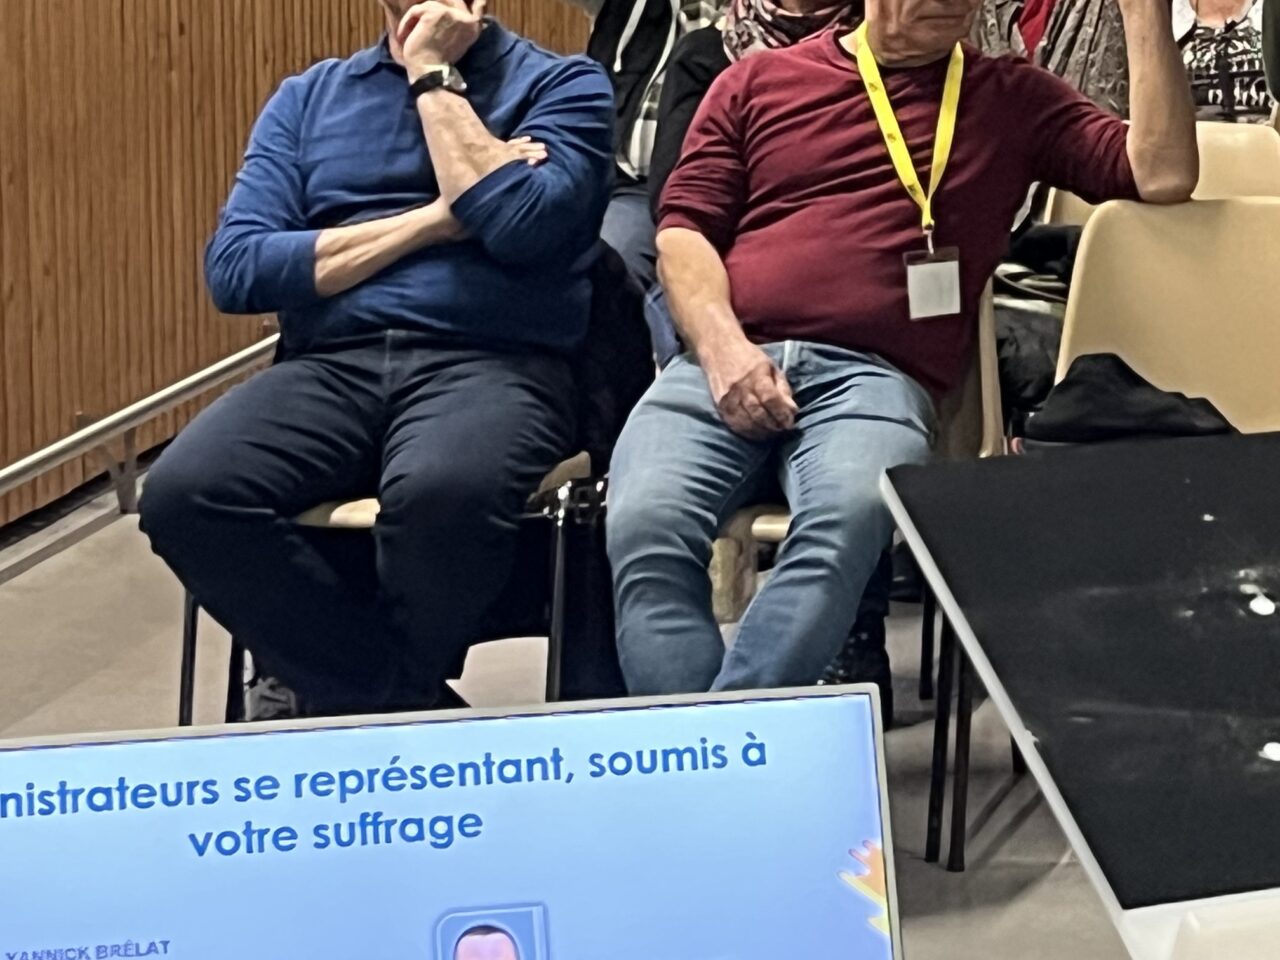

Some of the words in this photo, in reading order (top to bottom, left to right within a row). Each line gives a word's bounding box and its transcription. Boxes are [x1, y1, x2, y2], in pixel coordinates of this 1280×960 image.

[0, 776, 220, 818] nistrateurs
[233, 774, 281, 803] se
[293, 746, 574, 803] représentant,
[588, 737, 729, 778] soumis
[741, 731, 767, 767] à
[188, 820, 299, 857] votre
[312, 811, 484, 849] suffrage
